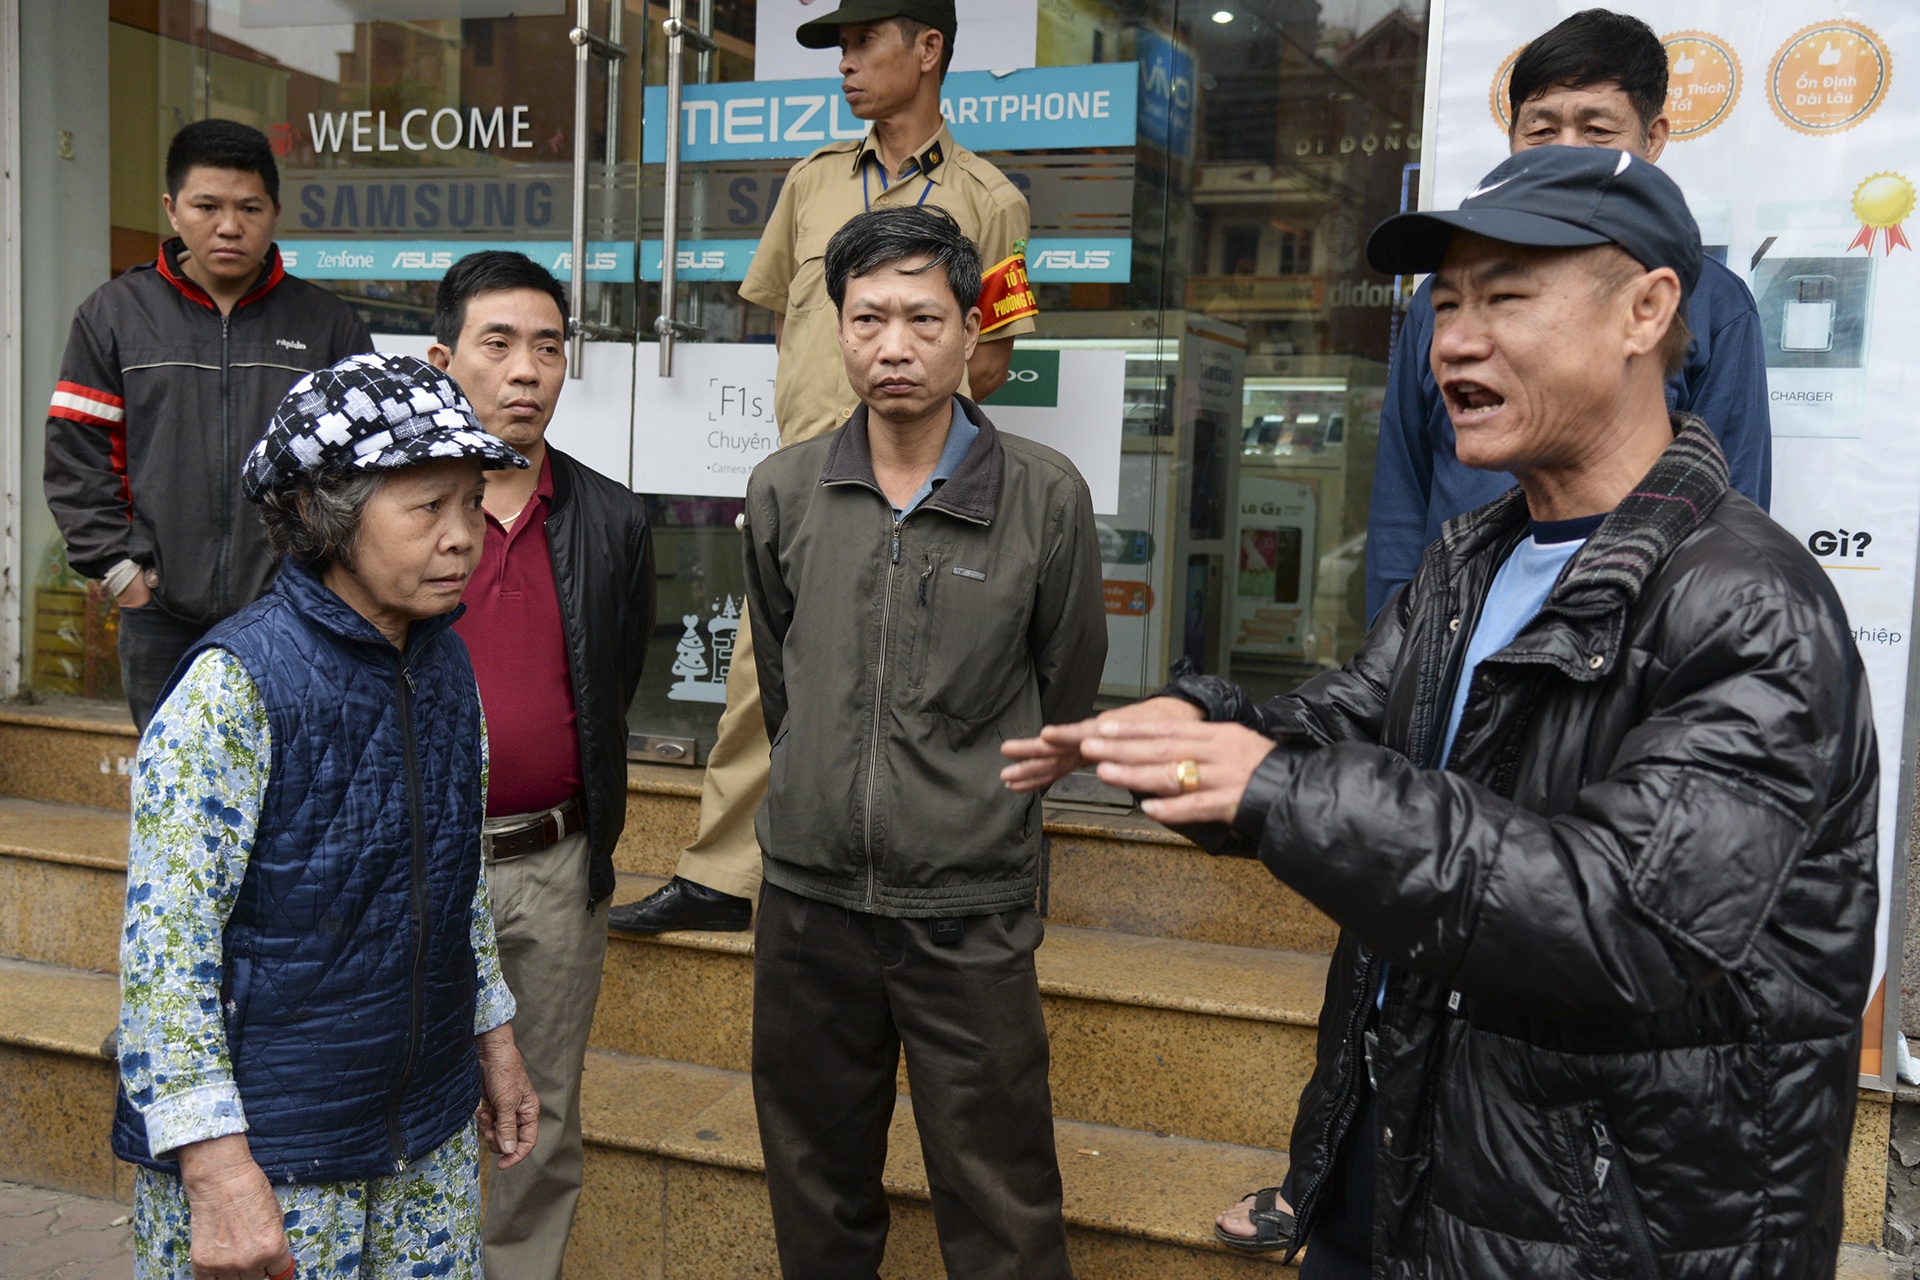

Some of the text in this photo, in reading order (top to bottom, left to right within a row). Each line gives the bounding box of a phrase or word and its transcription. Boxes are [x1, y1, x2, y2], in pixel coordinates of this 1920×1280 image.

[1688, 82, 1726, 95] Thích
[1796, 71, 1857, 91] Ổn Định
[1671, 98, 1692, 112] Tốt
[1796, 91, 1853, 105] Dài Lâu
[940, 90, 1110, 125] ARTPHONE
[308, 105, 533, 153] WELCOME
[301, 182, 553, 229] SAMSUNG
[317, 251, 374, 268] Zenfone
[391, 252, 452, 268] ASUS
[1032, 251, 1111, 269] ASUS
[721, 386, 763, 417] F1s
[1770, 391, 1833, 402] CHARGER
[708, 432, 771, 453] Chuyên
[711, 463, 746, 474] Camera
[1808, 528, 1872, 557] Gì?
